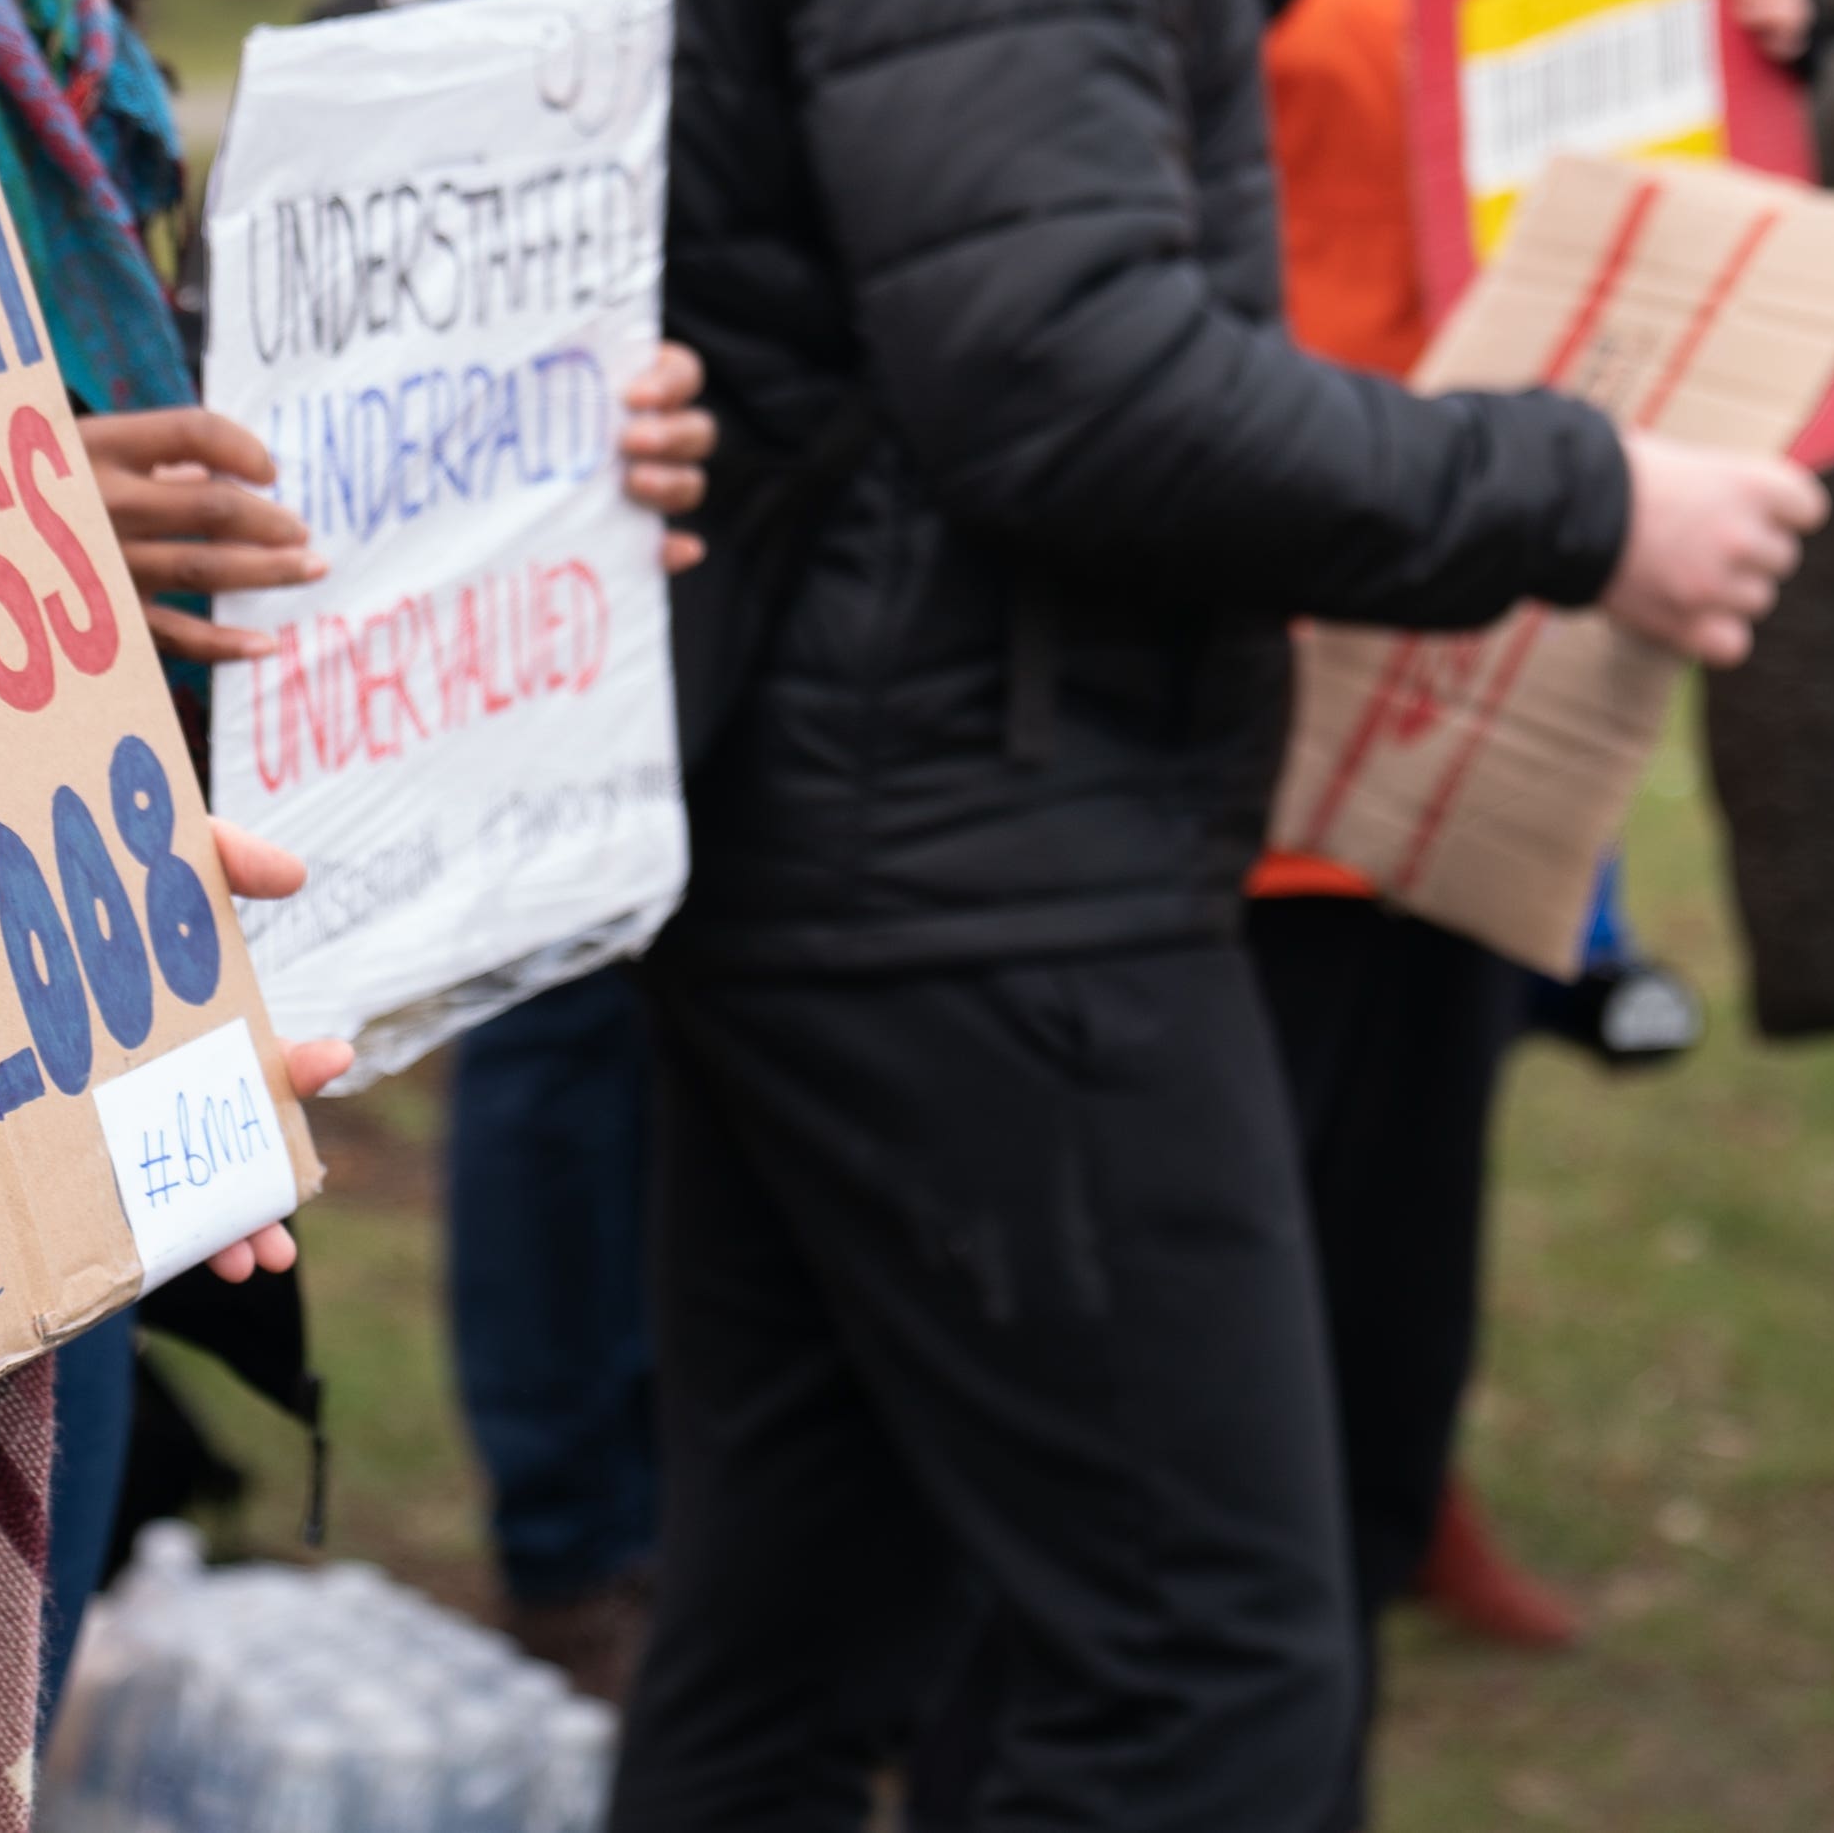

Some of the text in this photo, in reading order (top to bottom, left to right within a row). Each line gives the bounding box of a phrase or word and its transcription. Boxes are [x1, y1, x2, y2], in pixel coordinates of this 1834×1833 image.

[245, 162, 644, 365] UNDERSTAFFED
[268, 346, 609, 545] UNDERPAID
[249, 557, 611, 795] UNDERVALUED
[138, 1076, 270, 1209] #BMA
